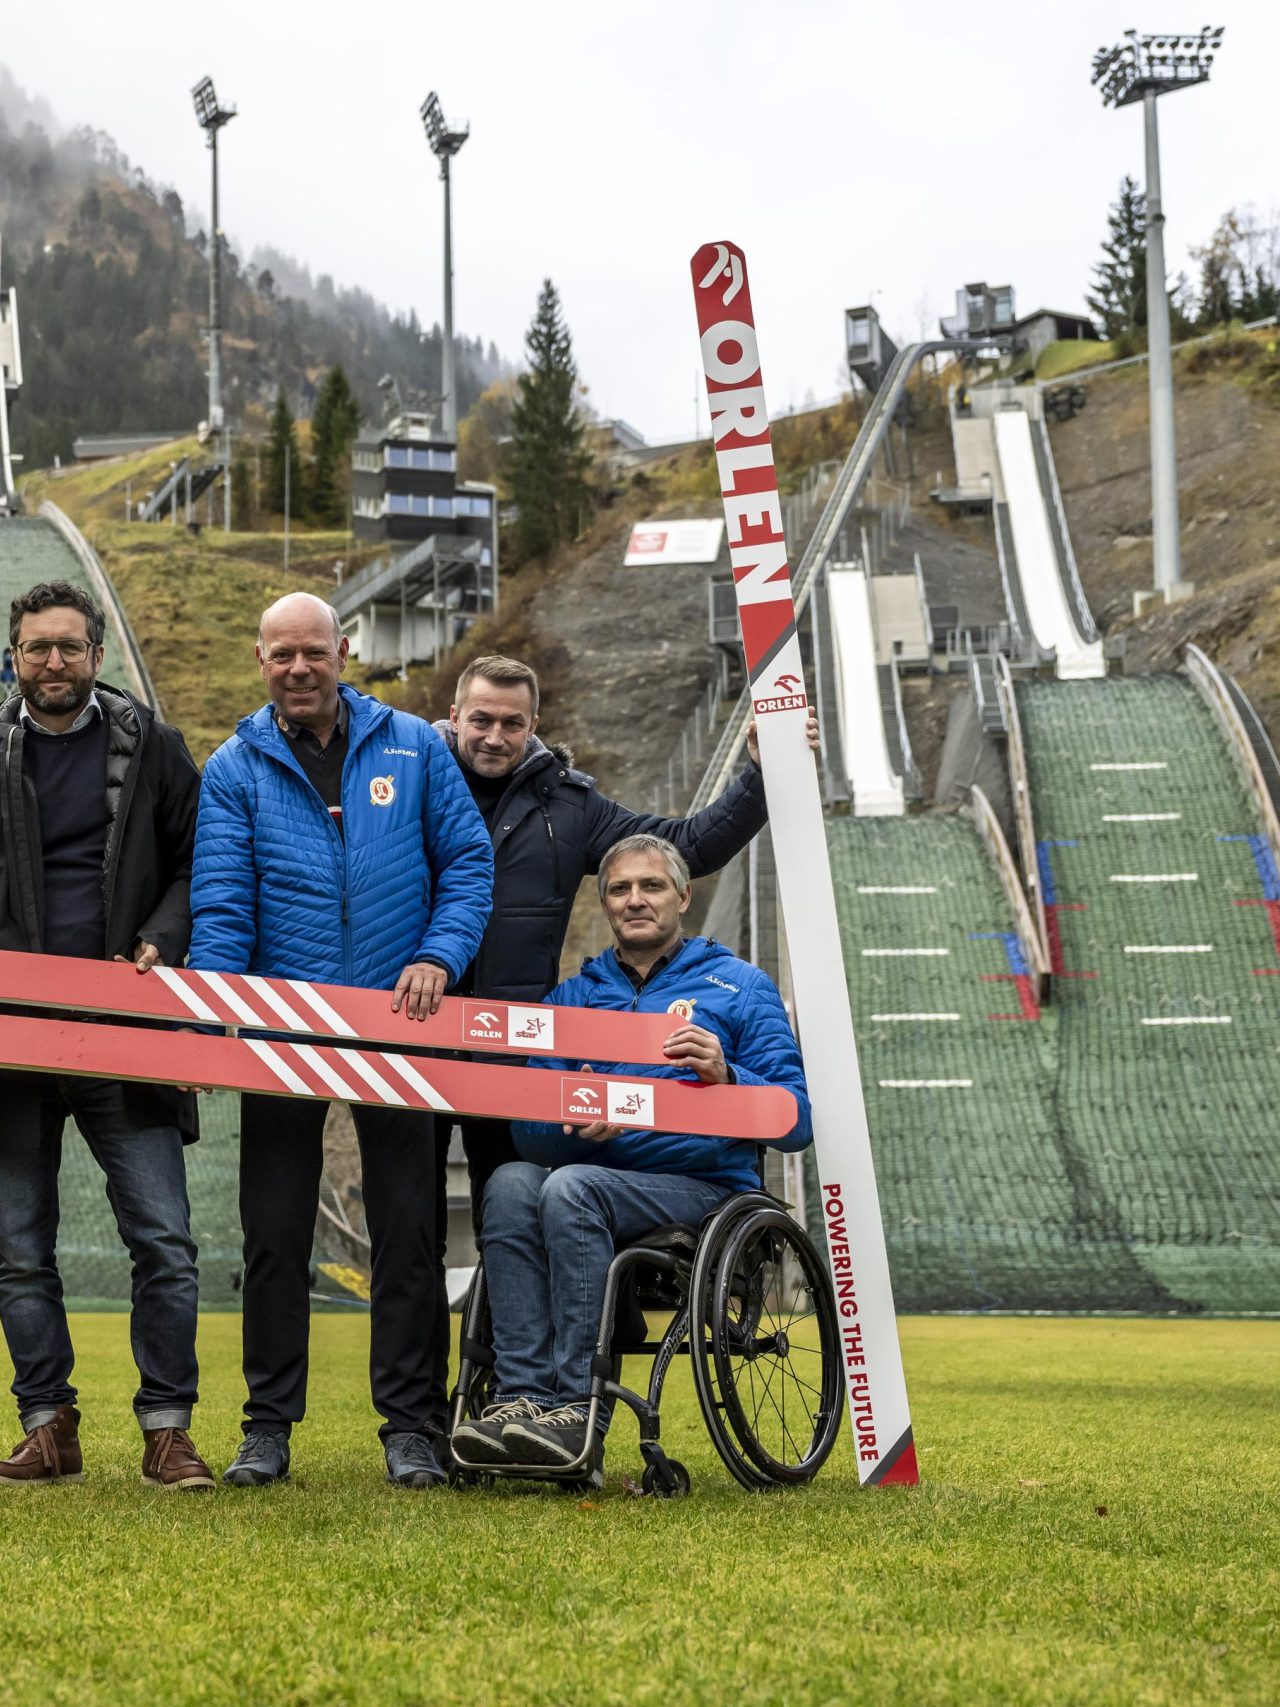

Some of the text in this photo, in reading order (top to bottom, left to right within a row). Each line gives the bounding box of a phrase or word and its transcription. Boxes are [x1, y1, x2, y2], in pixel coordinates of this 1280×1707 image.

[700, 320, 793, 606] ORLEN
[756, 696, 804, 713] ORLEN
[469, 1029, 503, 1040] ORLEN
[515, 1029, 538, 1040] star
[569, 1104, 602, 1116] ORLEN
[615, 1105, 638, 1116] star
[823, 1183, 879, 1462] POWERING THE FUTURE
